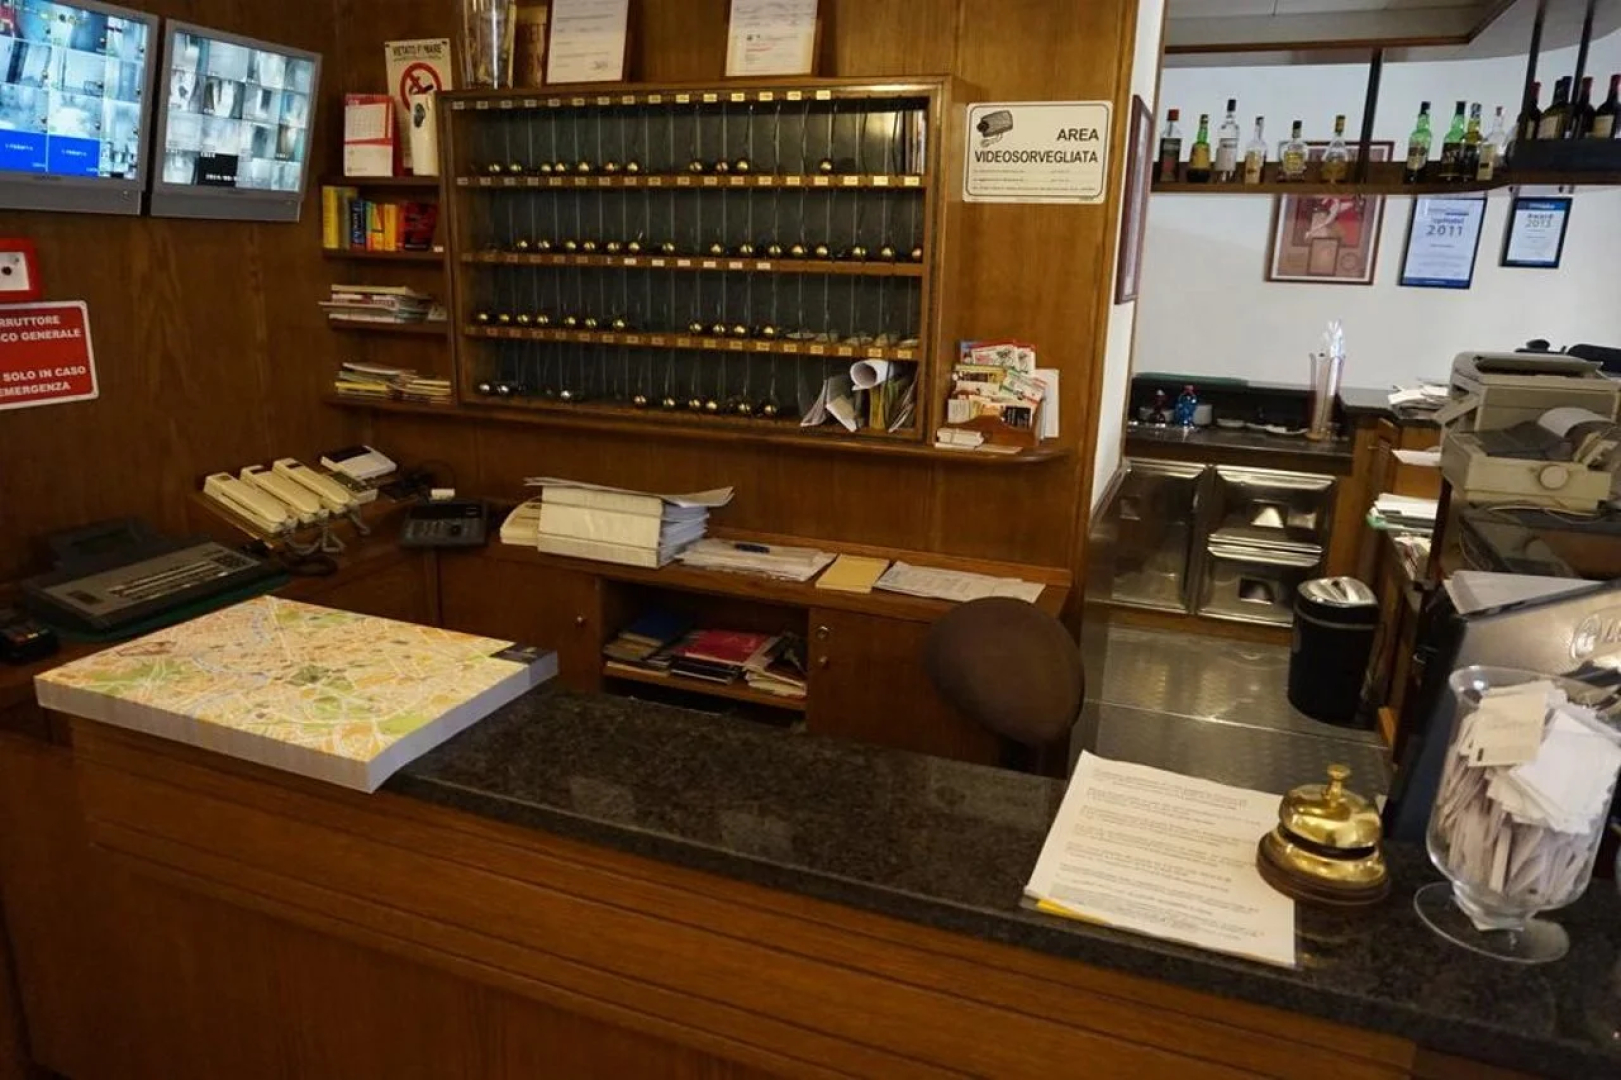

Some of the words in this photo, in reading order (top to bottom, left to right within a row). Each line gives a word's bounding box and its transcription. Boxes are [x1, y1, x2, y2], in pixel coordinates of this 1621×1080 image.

[417, 43, 442, 54] FMARE
[1056, 128, 1100, 142] AREA
[974, 150, 1099, 164] VIDEOSORVEGLIATA
[1426, 224, 1464, 237] 2011
[0, 315, 60, 328] RRUTTORE
[0, 332, 19, 343] CO
[21, 328, 82, 341] GENERALE
[3, 370, 37, 382] SOLO
[39, 368, 53, 378] IN
[55, 365, 87, 377] CASO
[0, 381, 72, 397] EMERGENZA
